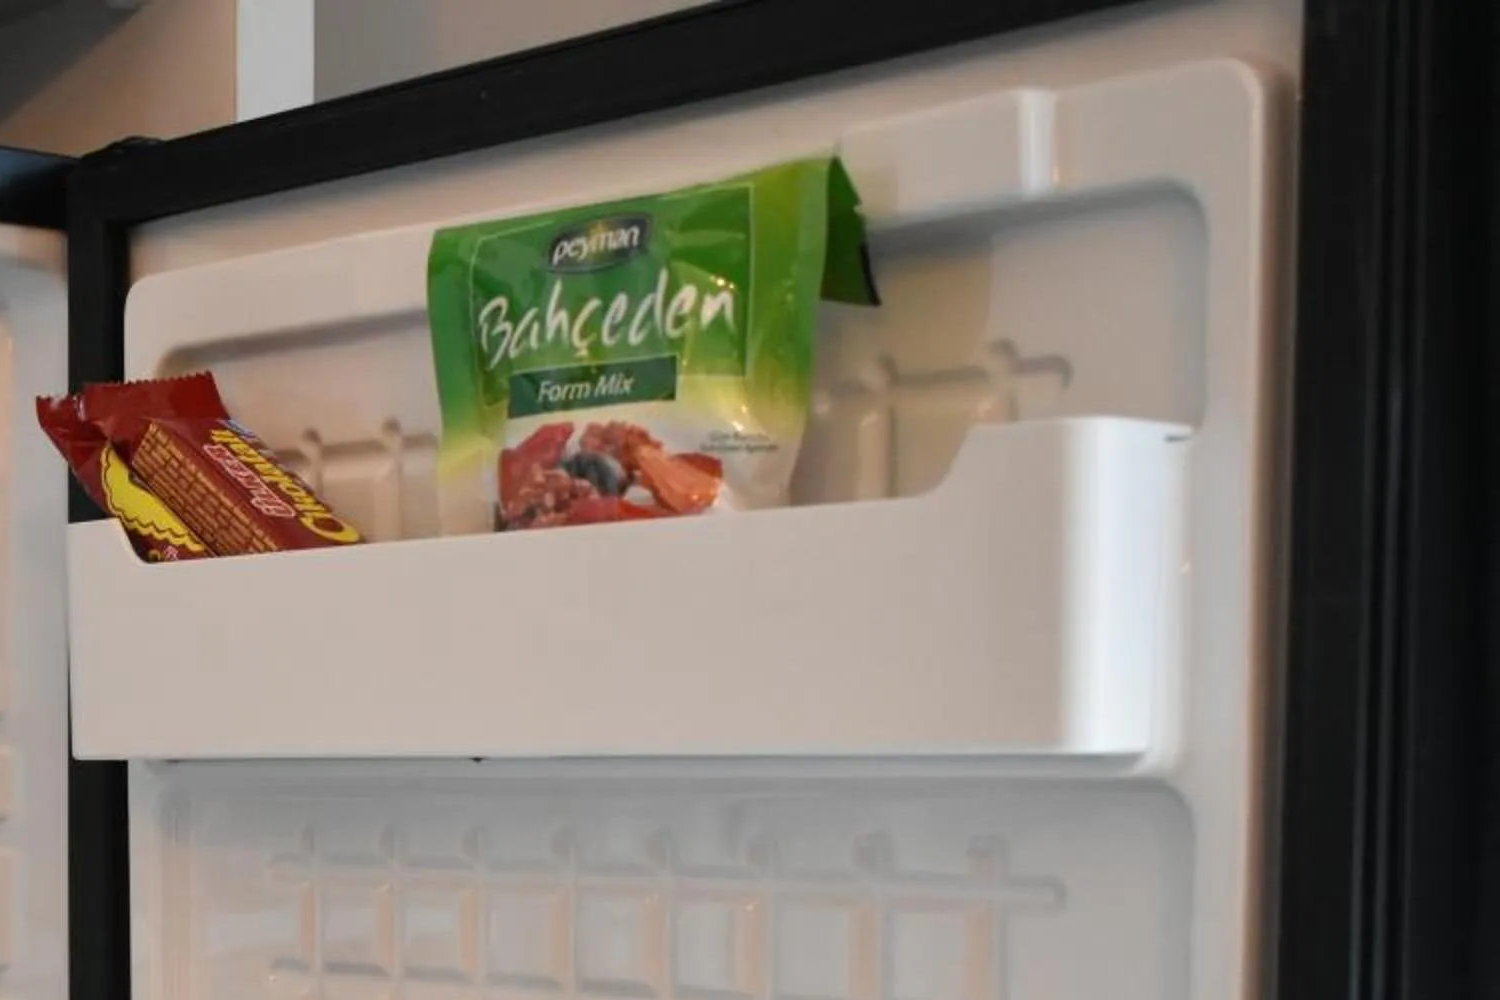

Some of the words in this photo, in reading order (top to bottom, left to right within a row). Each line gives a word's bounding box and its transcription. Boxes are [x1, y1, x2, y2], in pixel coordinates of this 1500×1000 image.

[553, 224, 640, 267] peyman
[478, 268, 737, 370] Bahçeden
[538, 379, 591, 403] Form
[596, 375, 636, 397] Mix
